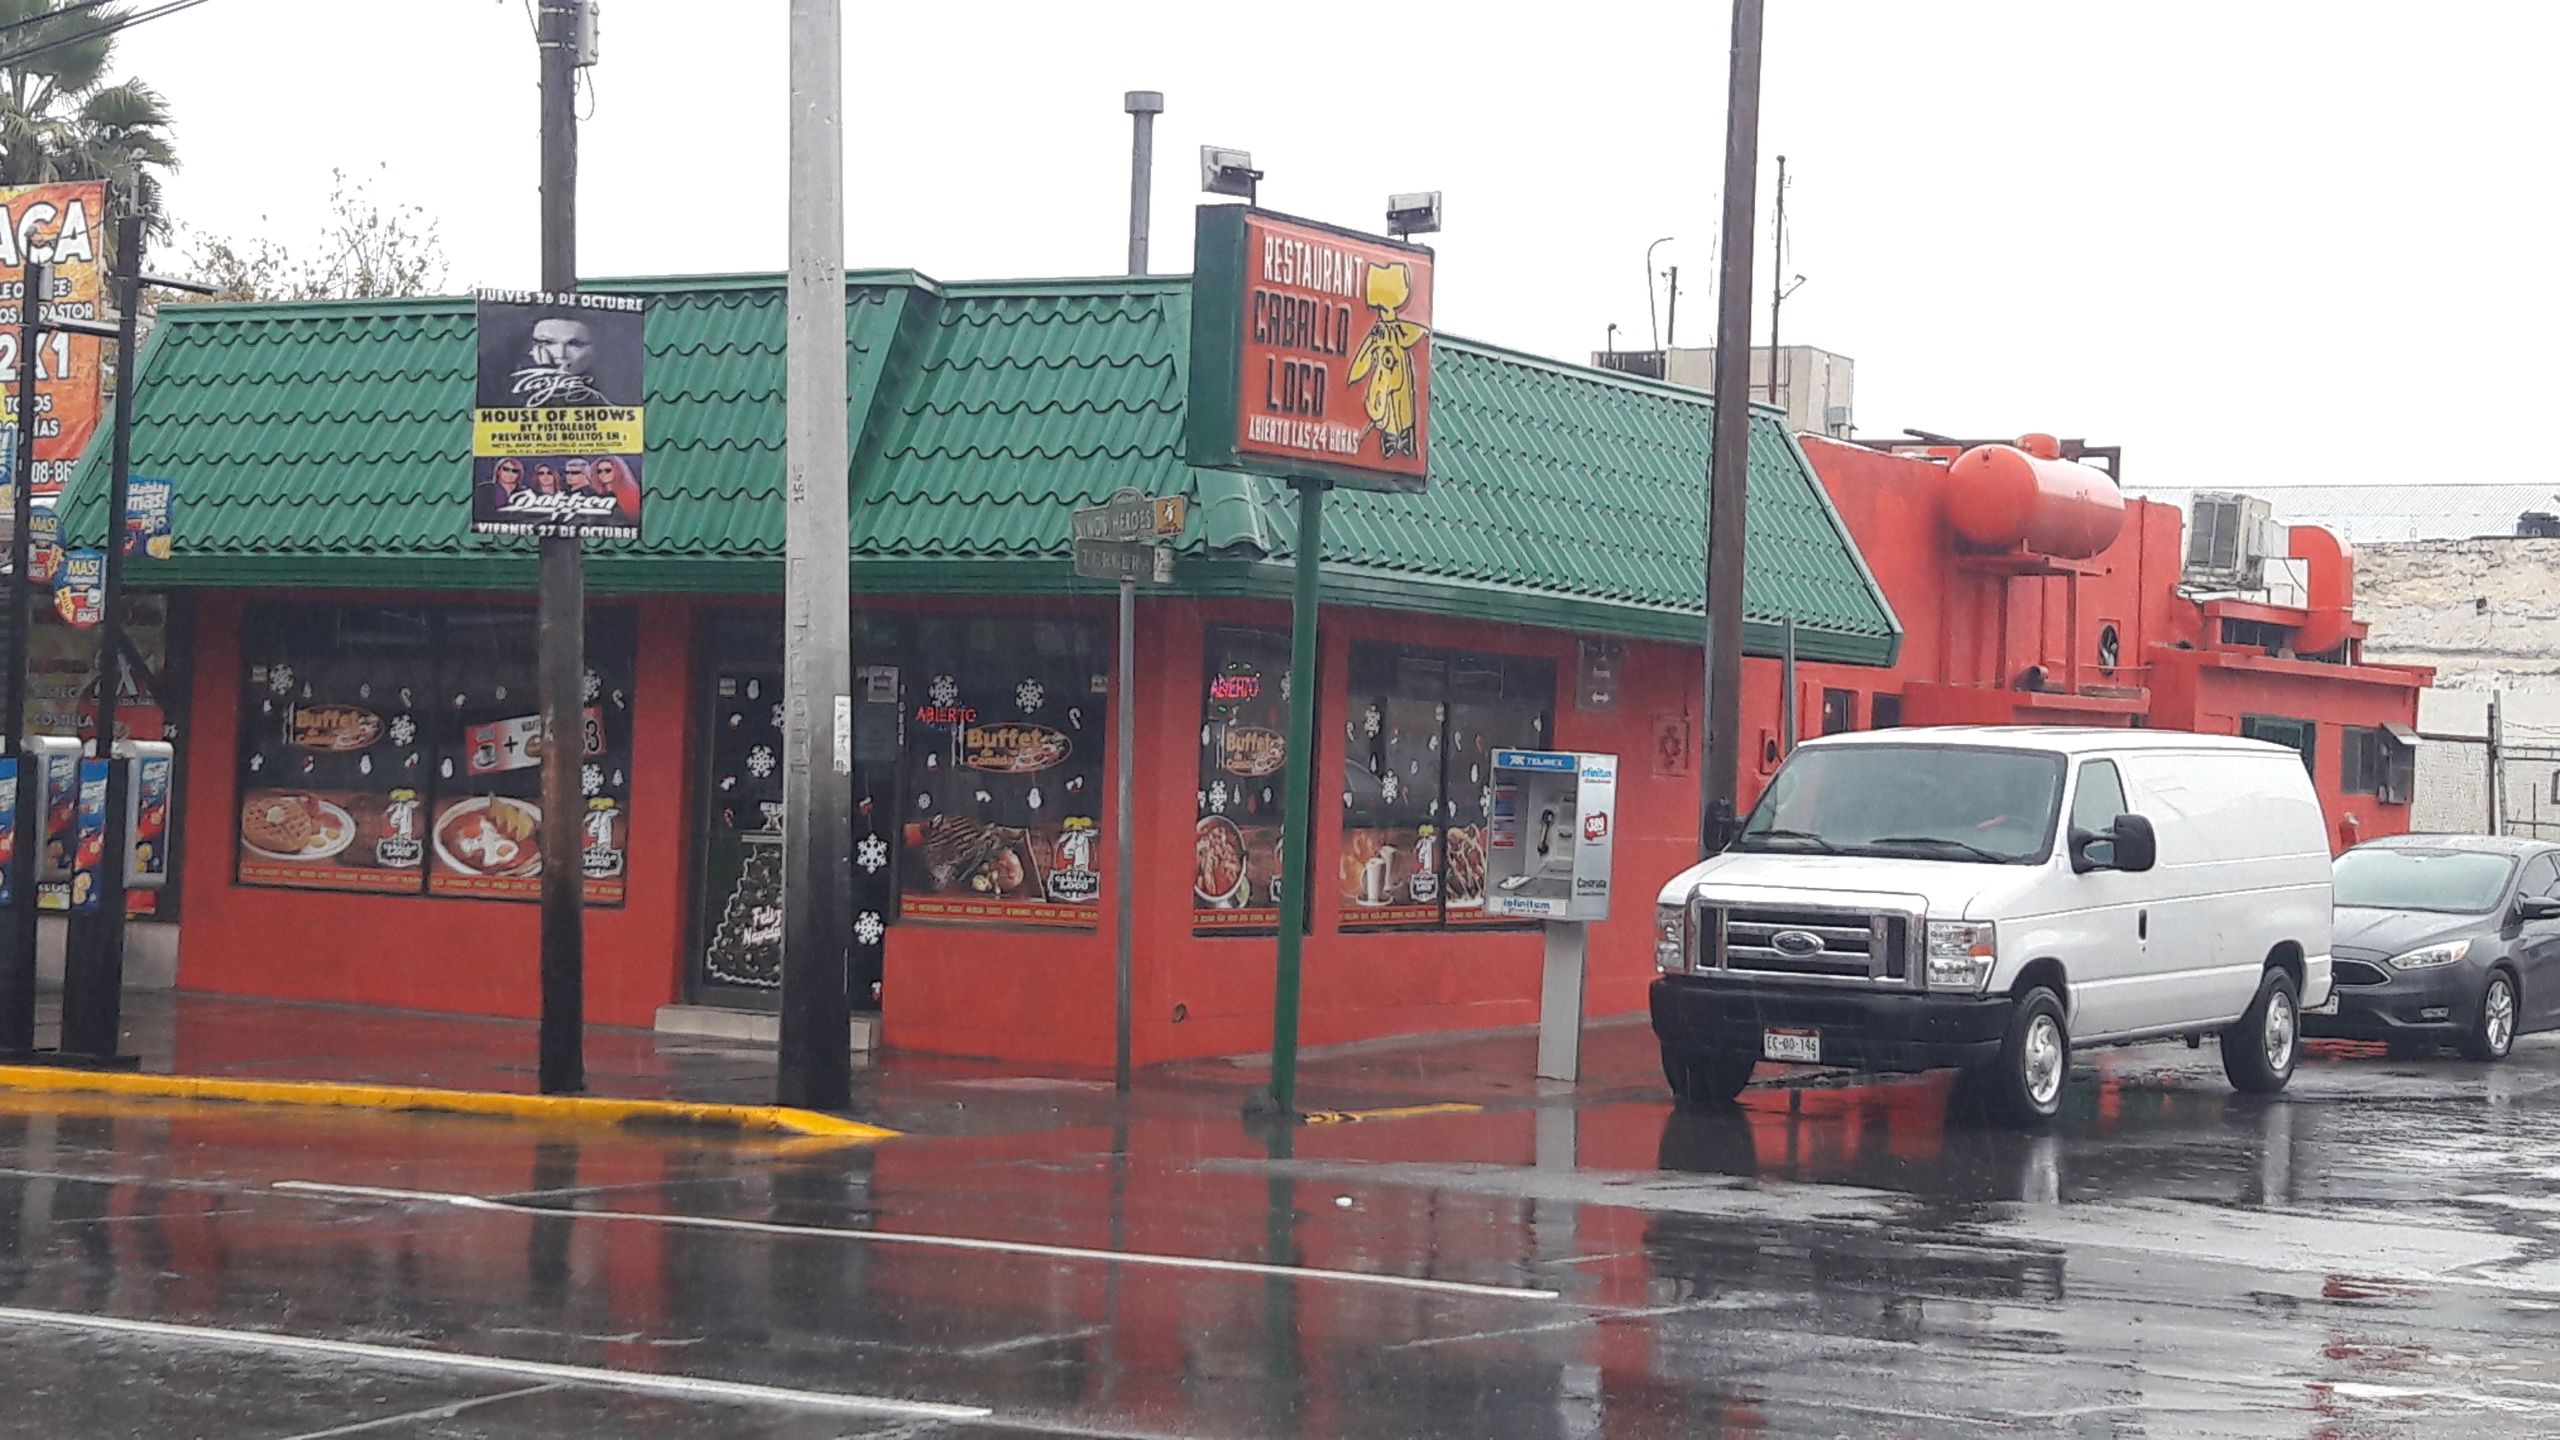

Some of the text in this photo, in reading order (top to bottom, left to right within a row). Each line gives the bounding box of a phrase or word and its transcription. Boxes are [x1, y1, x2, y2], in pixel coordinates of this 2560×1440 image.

[1263, 235, 1364, 299] RESTAURANT
[479, 288, 644, 312] JUEVES 26 DE OCTUBRE
[38, 303, 94, 323] PASTOR
[1253, 288, 1353, 358] CABALLO
[1265, 353, 1328, 417] LOCO
[33, 415, 60, 437] ÍAS
[481, 409, 636, 423] HOUSE OF SHOWS
[491, 433, 542, 442] PREVENTA
[546, 433, 557, 441] DE
[562, 432, 603, 441] BOLETOS
[520, 423, 597, 432] BY PISTOLEROS
[1248, 415, 1360, 455] ABIERTO LAS 24 HORAS
[31, 460, 80, 484] 08-86
[478, 522, 639, 539] VIERNES 27 DE OCTUBRE
[916, 705, 978, 723] ABIERTO
[967, 728, 1042, 748] Buffet
[1527, 757, 1563, 767] TELMEX
[1060, 880, 1089, 890] LOCO
